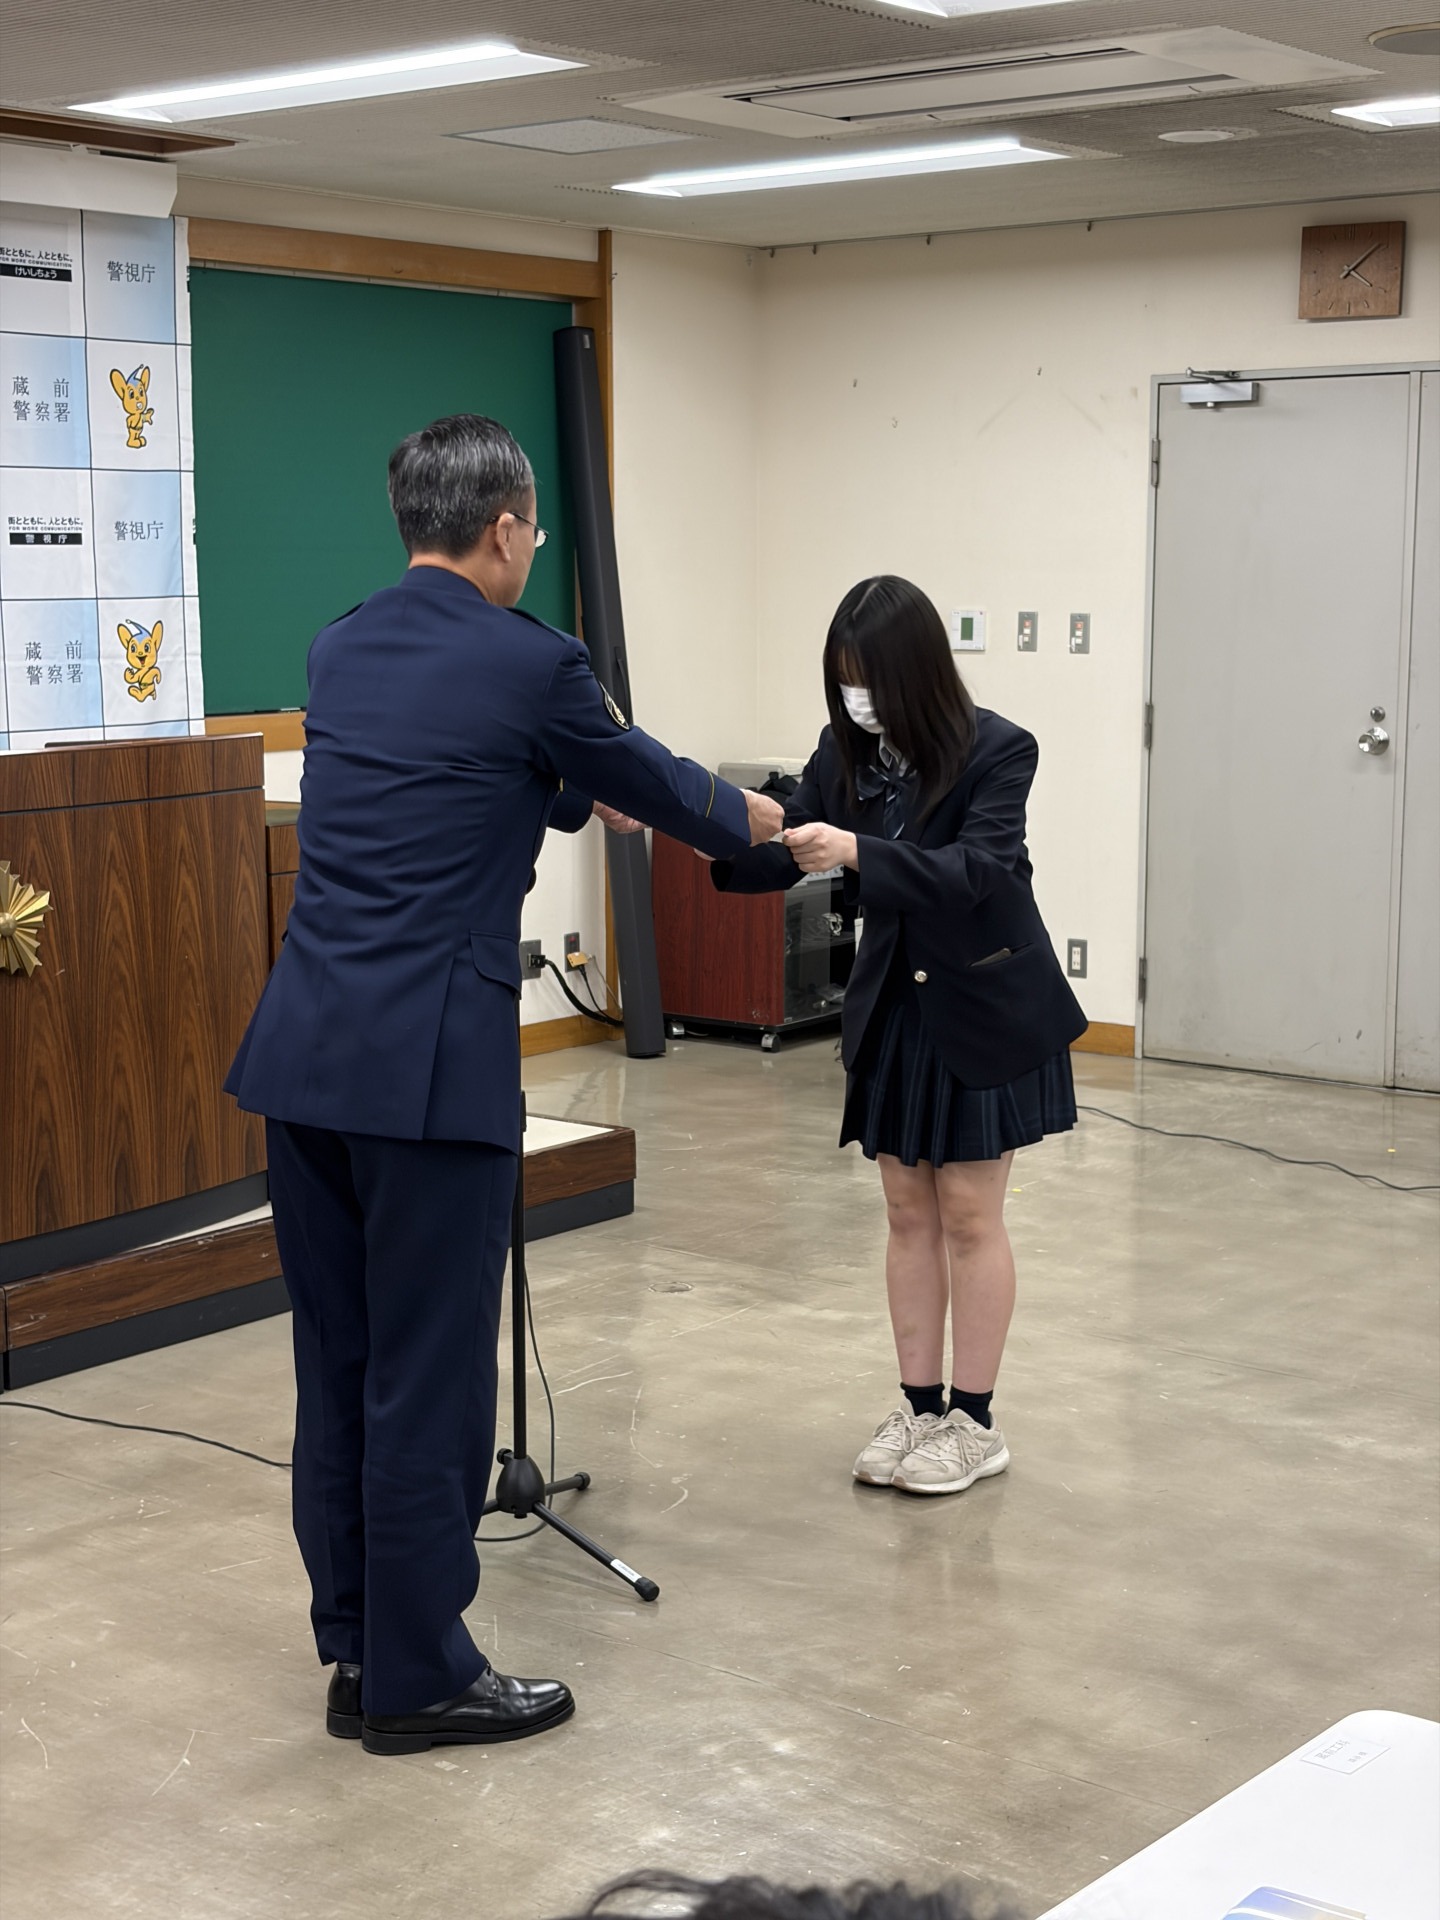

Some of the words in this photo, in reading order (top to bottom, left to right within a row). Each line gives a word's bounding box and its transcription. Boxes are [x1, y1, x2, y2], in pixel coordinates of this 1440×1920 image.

[15, 266, 58, 279] けいしちょう
[28, 259, 72, 268] COMMUNICATION
[106, 260, 156, 284] 警視庁
[12, 400, 71, 423] 警察署
[25, 534, 68, 544] 警視庁
[114, 520, 164, 541] 警視庁
[26, 663, 84, 686] 警察署
